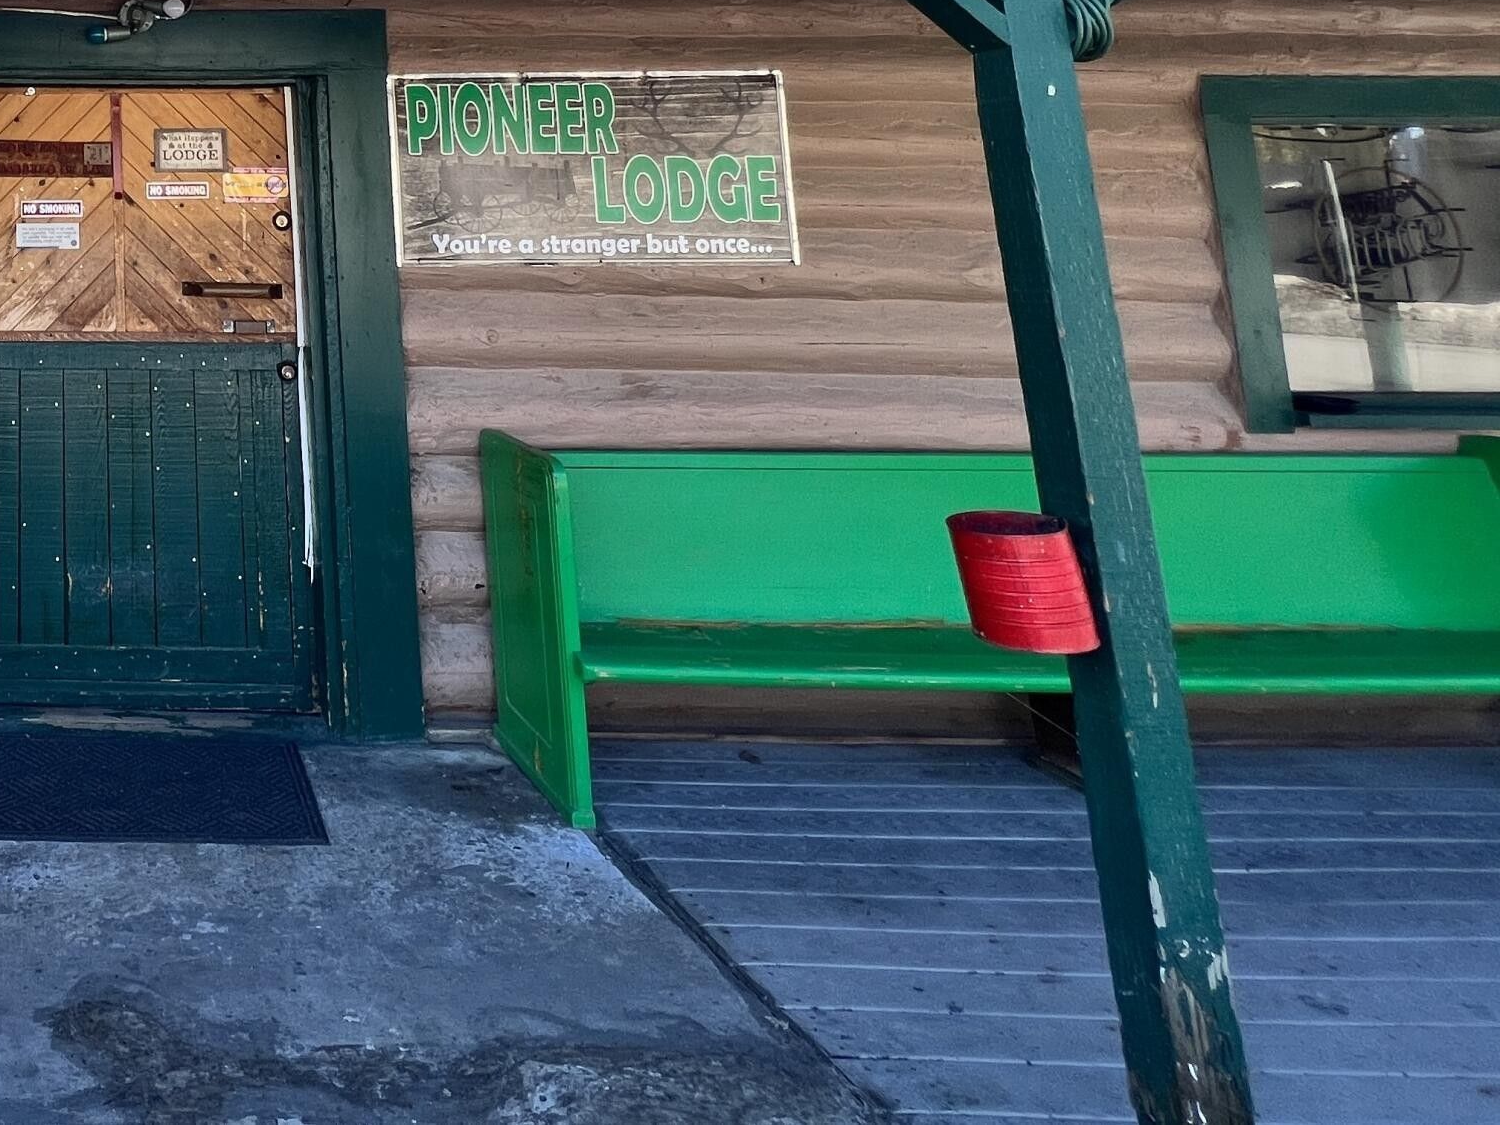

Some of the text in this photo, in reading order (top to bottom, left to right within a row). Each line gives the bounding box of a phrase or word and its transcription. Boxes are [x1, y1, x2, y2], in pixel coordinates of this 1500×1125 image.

[404, 82, 619, 156] PIONEER
[163, 150, 219, 160] LODGE
[150, 186, 206, 195] NO SMOKING
[591, 154, 781, 224] LODGE
[24, 204, 79, 213] NO SMOKING
[432, 234, 773, 261] You're a stranger but once...
